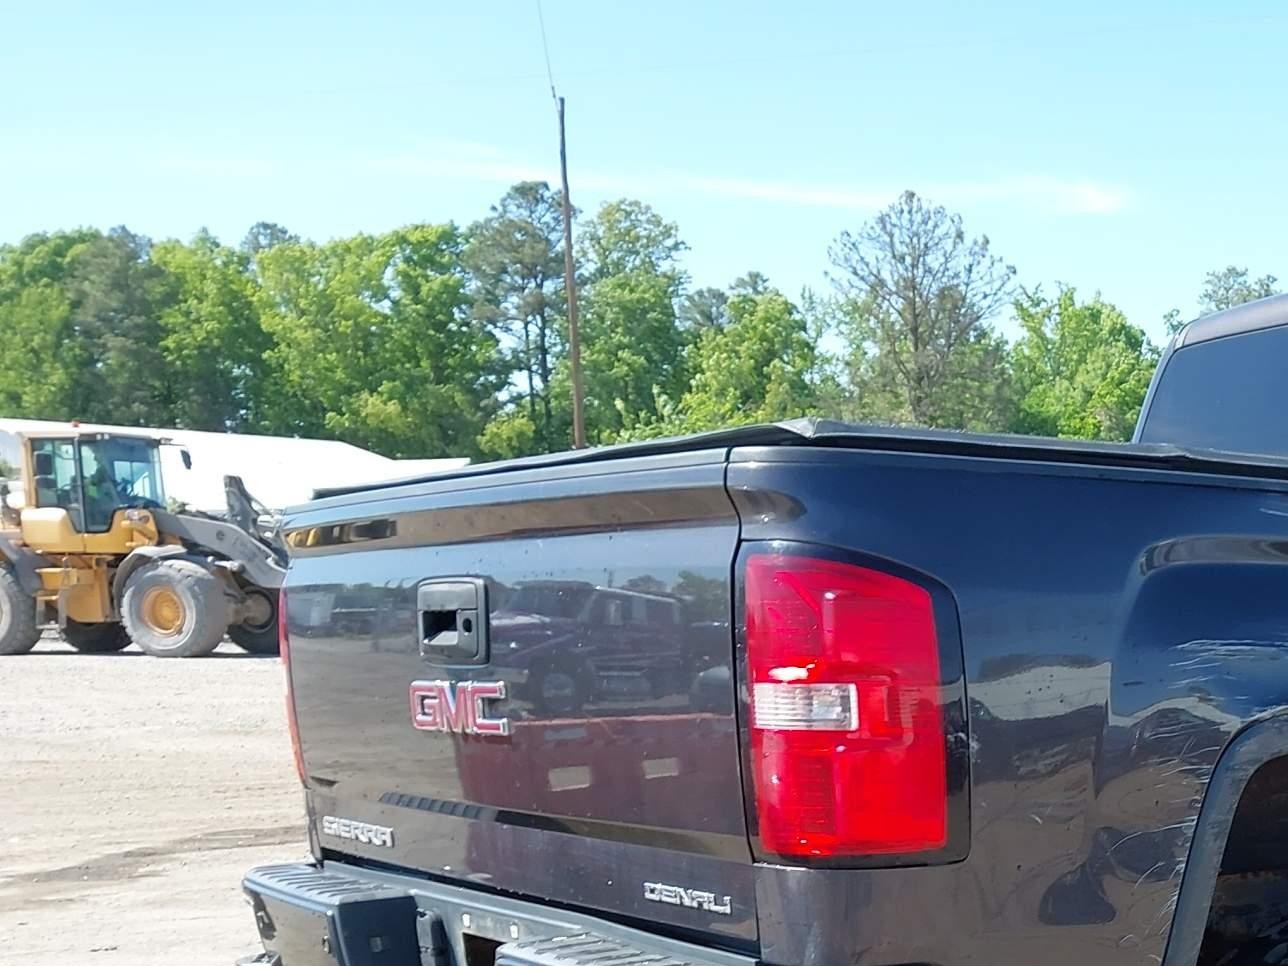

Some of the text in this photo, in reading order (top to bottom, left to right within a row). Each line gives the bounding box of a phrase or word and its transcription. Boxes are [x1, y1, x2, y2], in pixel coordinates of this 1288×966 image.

[409, 679, 509, 736] GMC
[322, 815, 394, 848] SIERRA
[643, 882, 732, 915] DENALI
